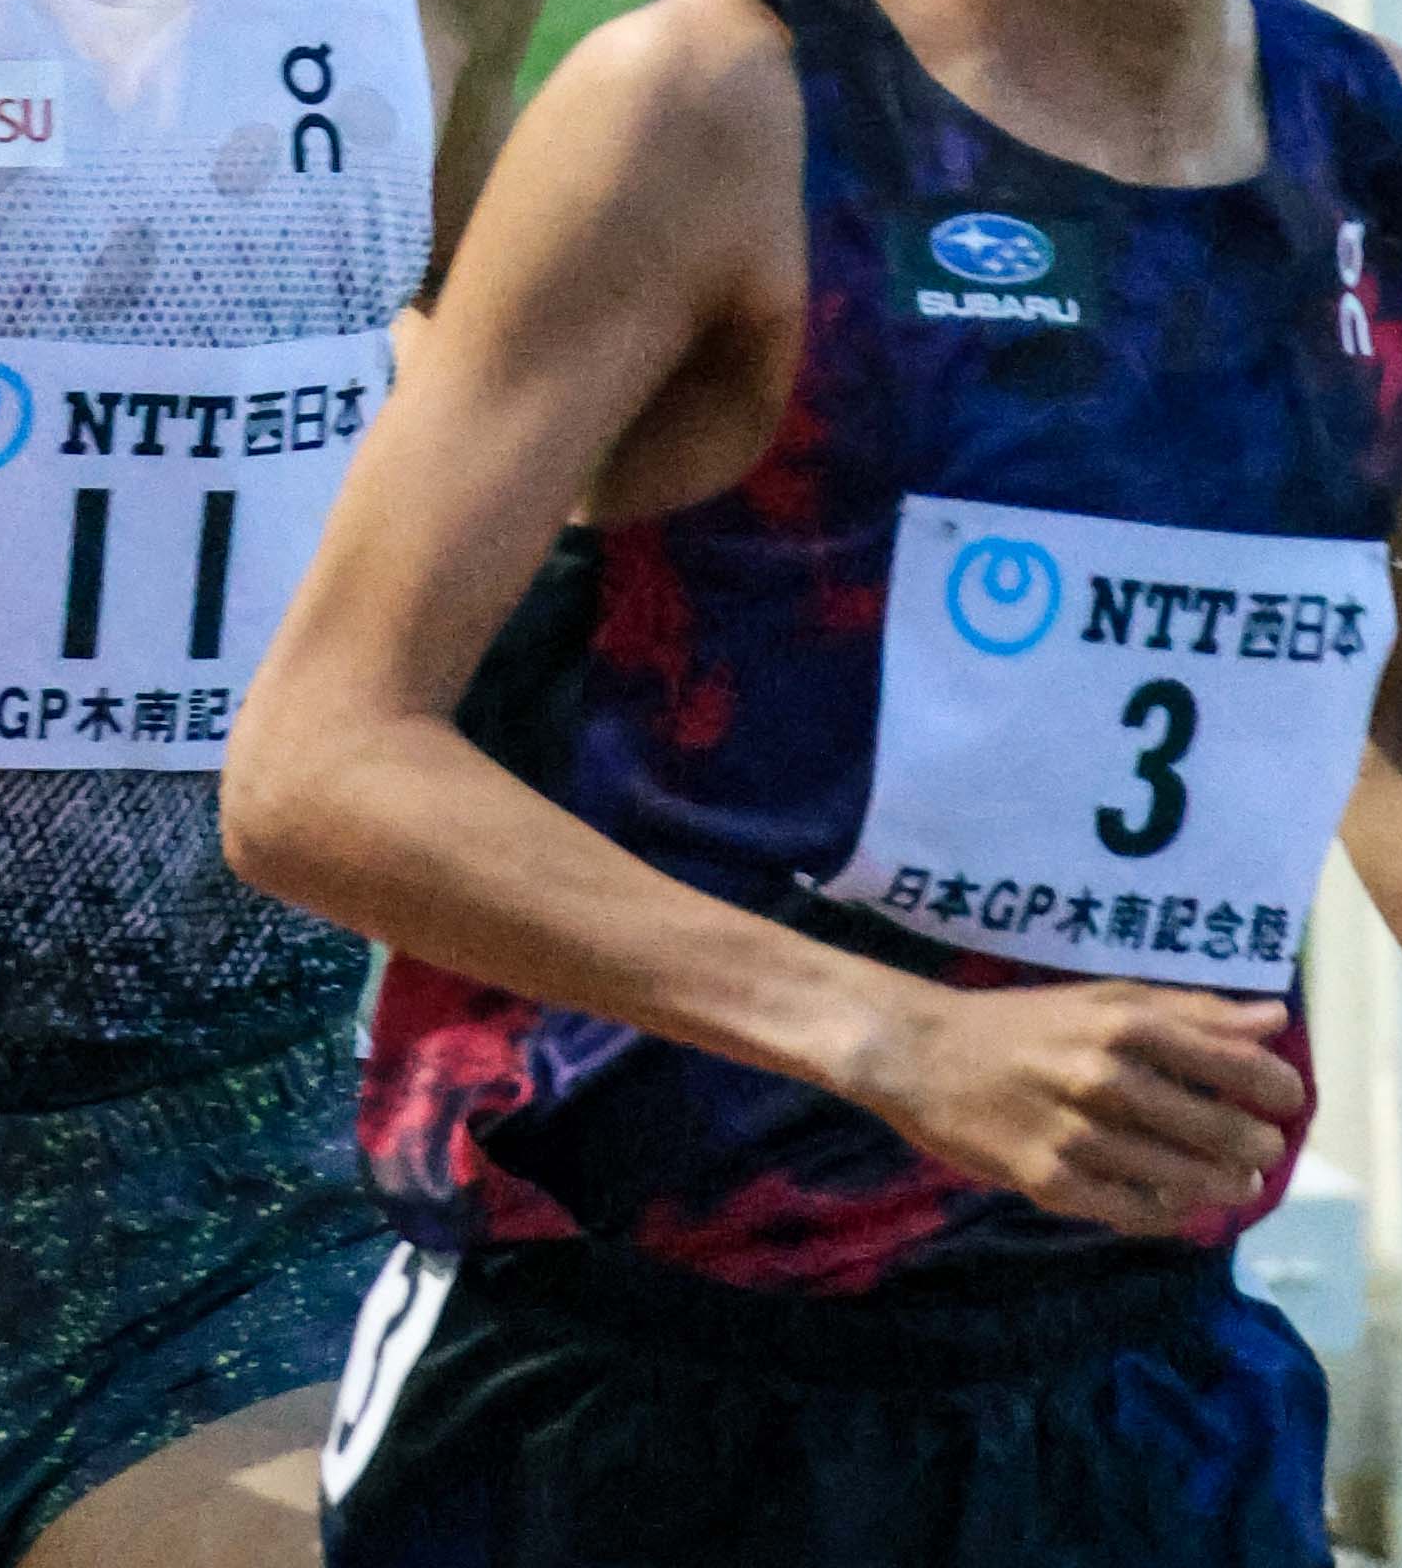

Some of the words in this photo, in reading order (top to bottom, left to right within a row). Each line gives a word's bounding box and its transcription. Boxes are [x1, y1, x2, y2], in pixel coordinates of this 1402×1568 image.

[916, 290, 1080, 324] SUBARU
[60, 376, 367, 458] NTT西日本
[61, 487, 237, 660] 11
[1081, 575, 1366, 663] NTT西日本
[1094, 677, 1199, 858] 3
